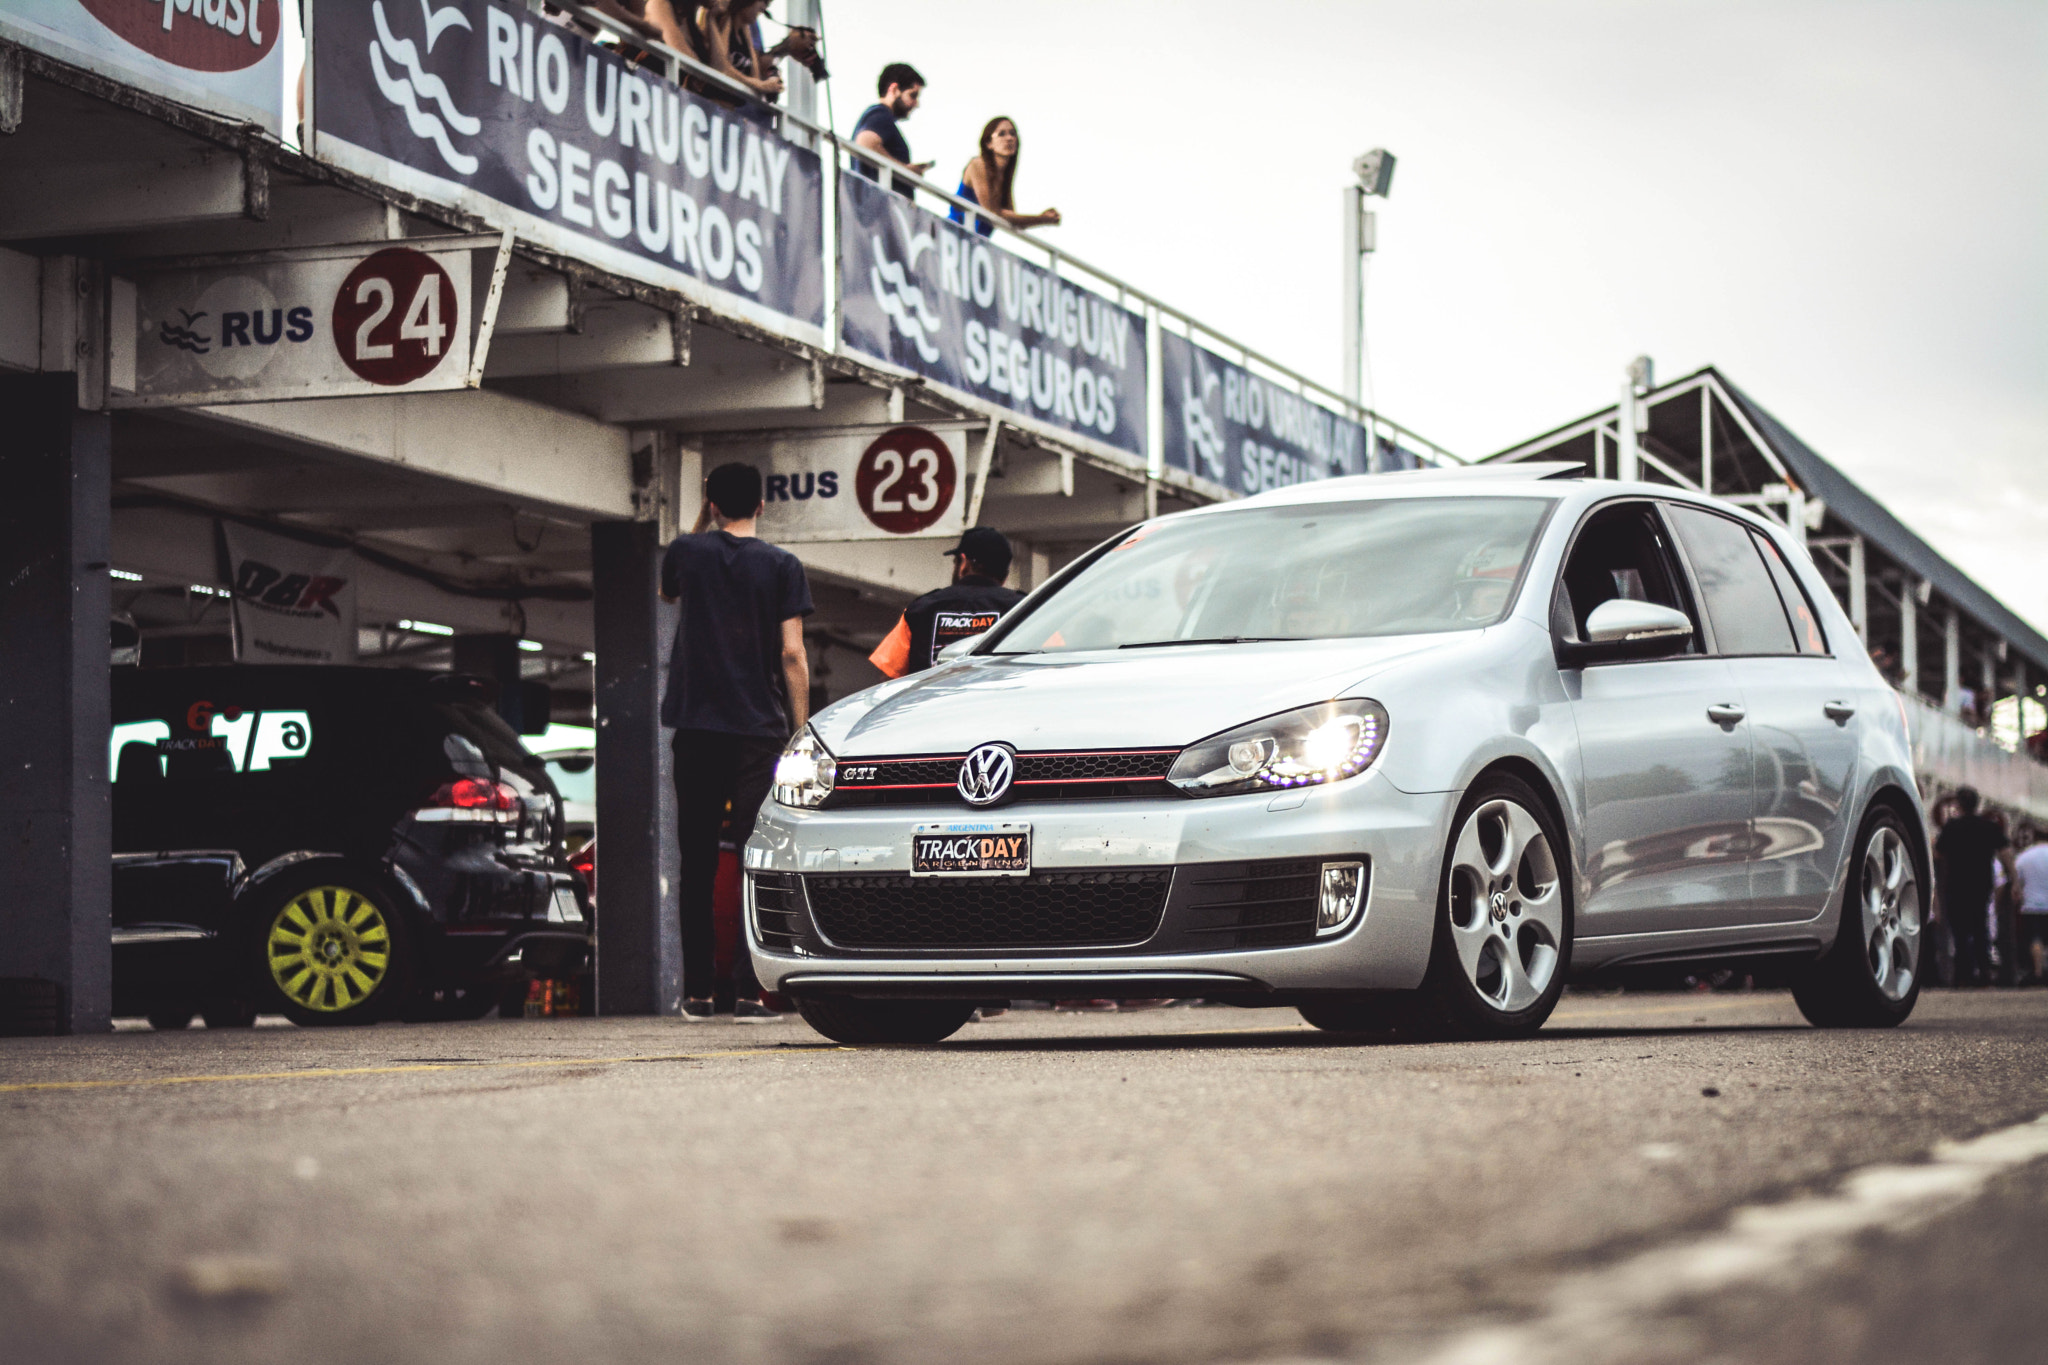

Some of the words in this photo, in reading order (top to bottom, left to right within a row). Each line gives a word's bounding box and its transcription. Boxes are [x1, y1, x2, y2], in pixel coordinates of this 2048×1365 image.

[487, 5, 569, 114] RIO
[585, 54, 790, 215] URUGUAY
[527, 128, 763, 292] SEGUROS
[222, 306, 314, 347] RUS
[356, 273, 446, 360] 24
[940, 229, 995, 308] RIO
[1002, 258, 1129, 370] URUGUAY
[965, 319, 1116, 435] SEGUROS
[1224, 367, 1265, 430] RIO
[766, 470, 839, 502] RUS
[873, 448, 939, 512] 23
[940, 617, 995, 627] TRACKDAY
[843, 767, 878, 780] GTI
[920, 838, 1022, 859] TRACKDAY
[947, 824, 994, 832] ARGENTINA
